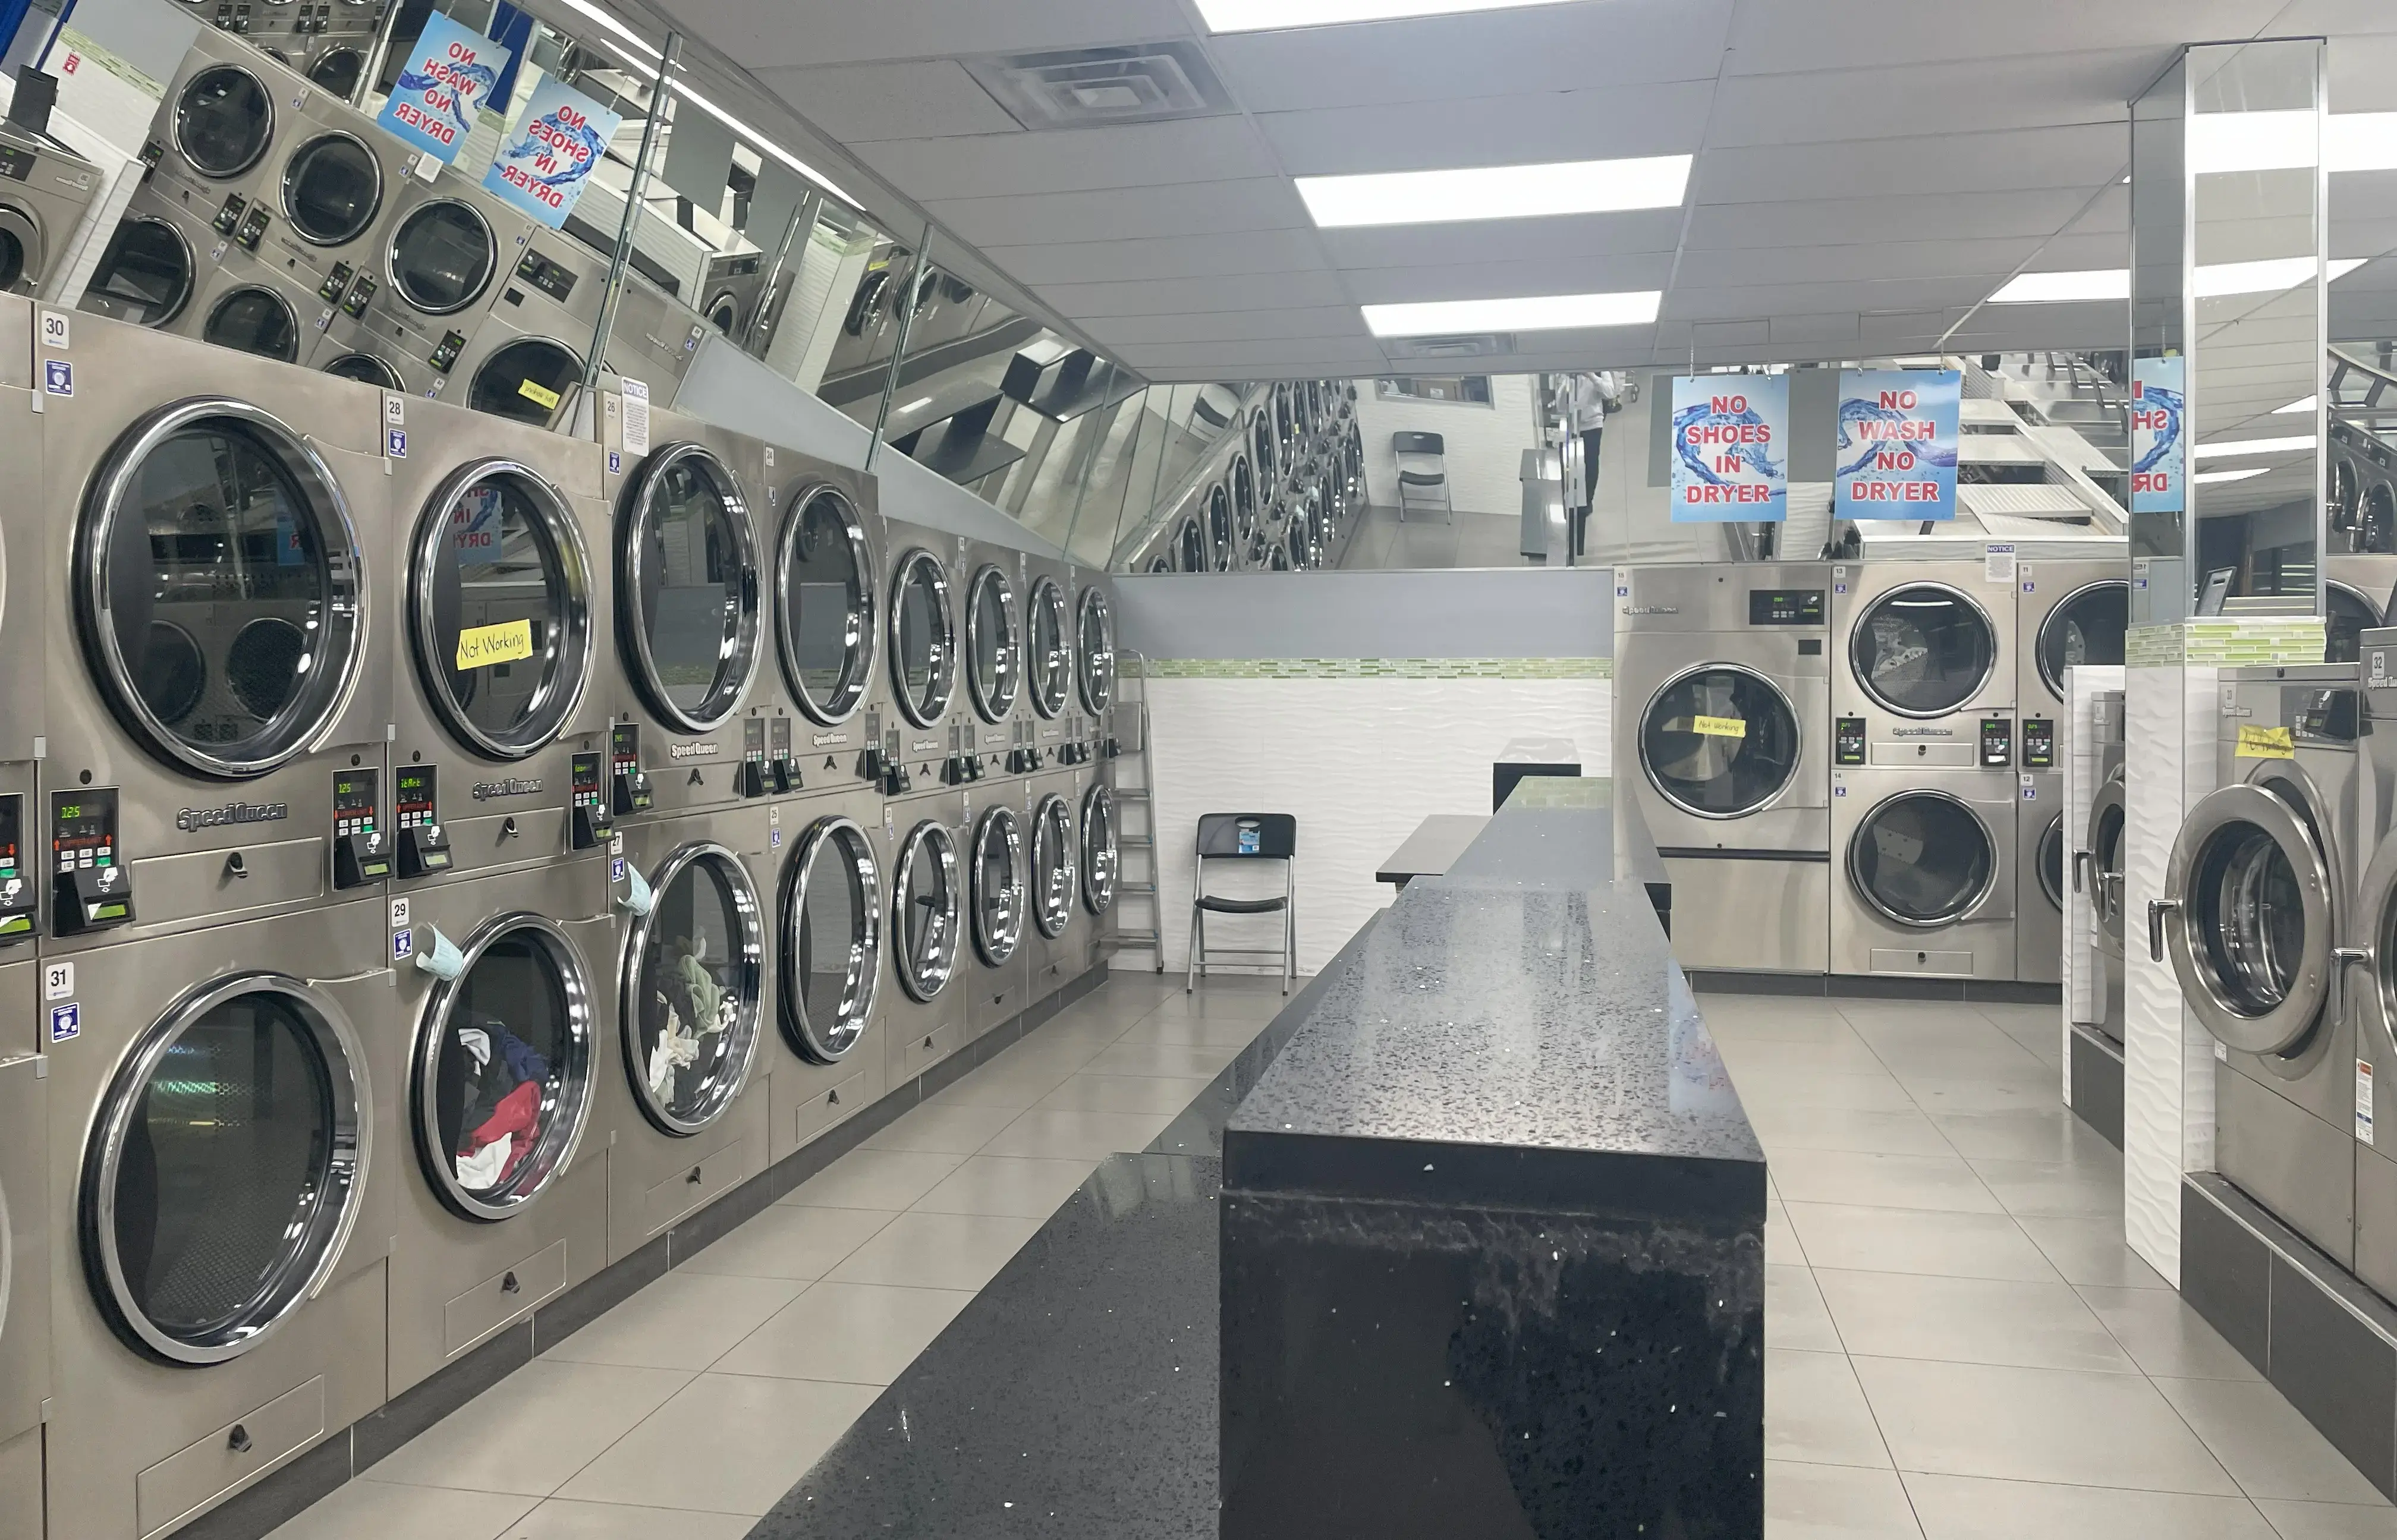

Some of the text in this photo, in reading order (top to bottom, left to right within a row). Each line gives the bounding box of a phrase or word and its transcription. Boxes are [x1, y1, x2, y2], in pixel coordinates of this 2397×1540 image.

[46, 317, 64, 336] 30
[623, 382, 647, 399] NOTICE
[1880, 390, 1917, 410] NO
[389, 401, 401, 415] 28
[607, 401, 615, 412] 26
[1712, 395, 1748, 414] NO
[1687, 424, 1772, 444] SHOES
[1858, 420, 1935, 440] WASH
[767, 450, 773, 459] 24
[1877, 452, 1915, 471] NO
[1716, 455, 1741, 474] IN
[1687, 484, 1770, 503] DRYER
[1851, 481, 1940, 502] DRYER
[460, 631, 524, 660] Not Working
[2374, 656, 2382, 669] 32
[394, 903, 405, 917] 29
[51, 969, 66, 987] 31
